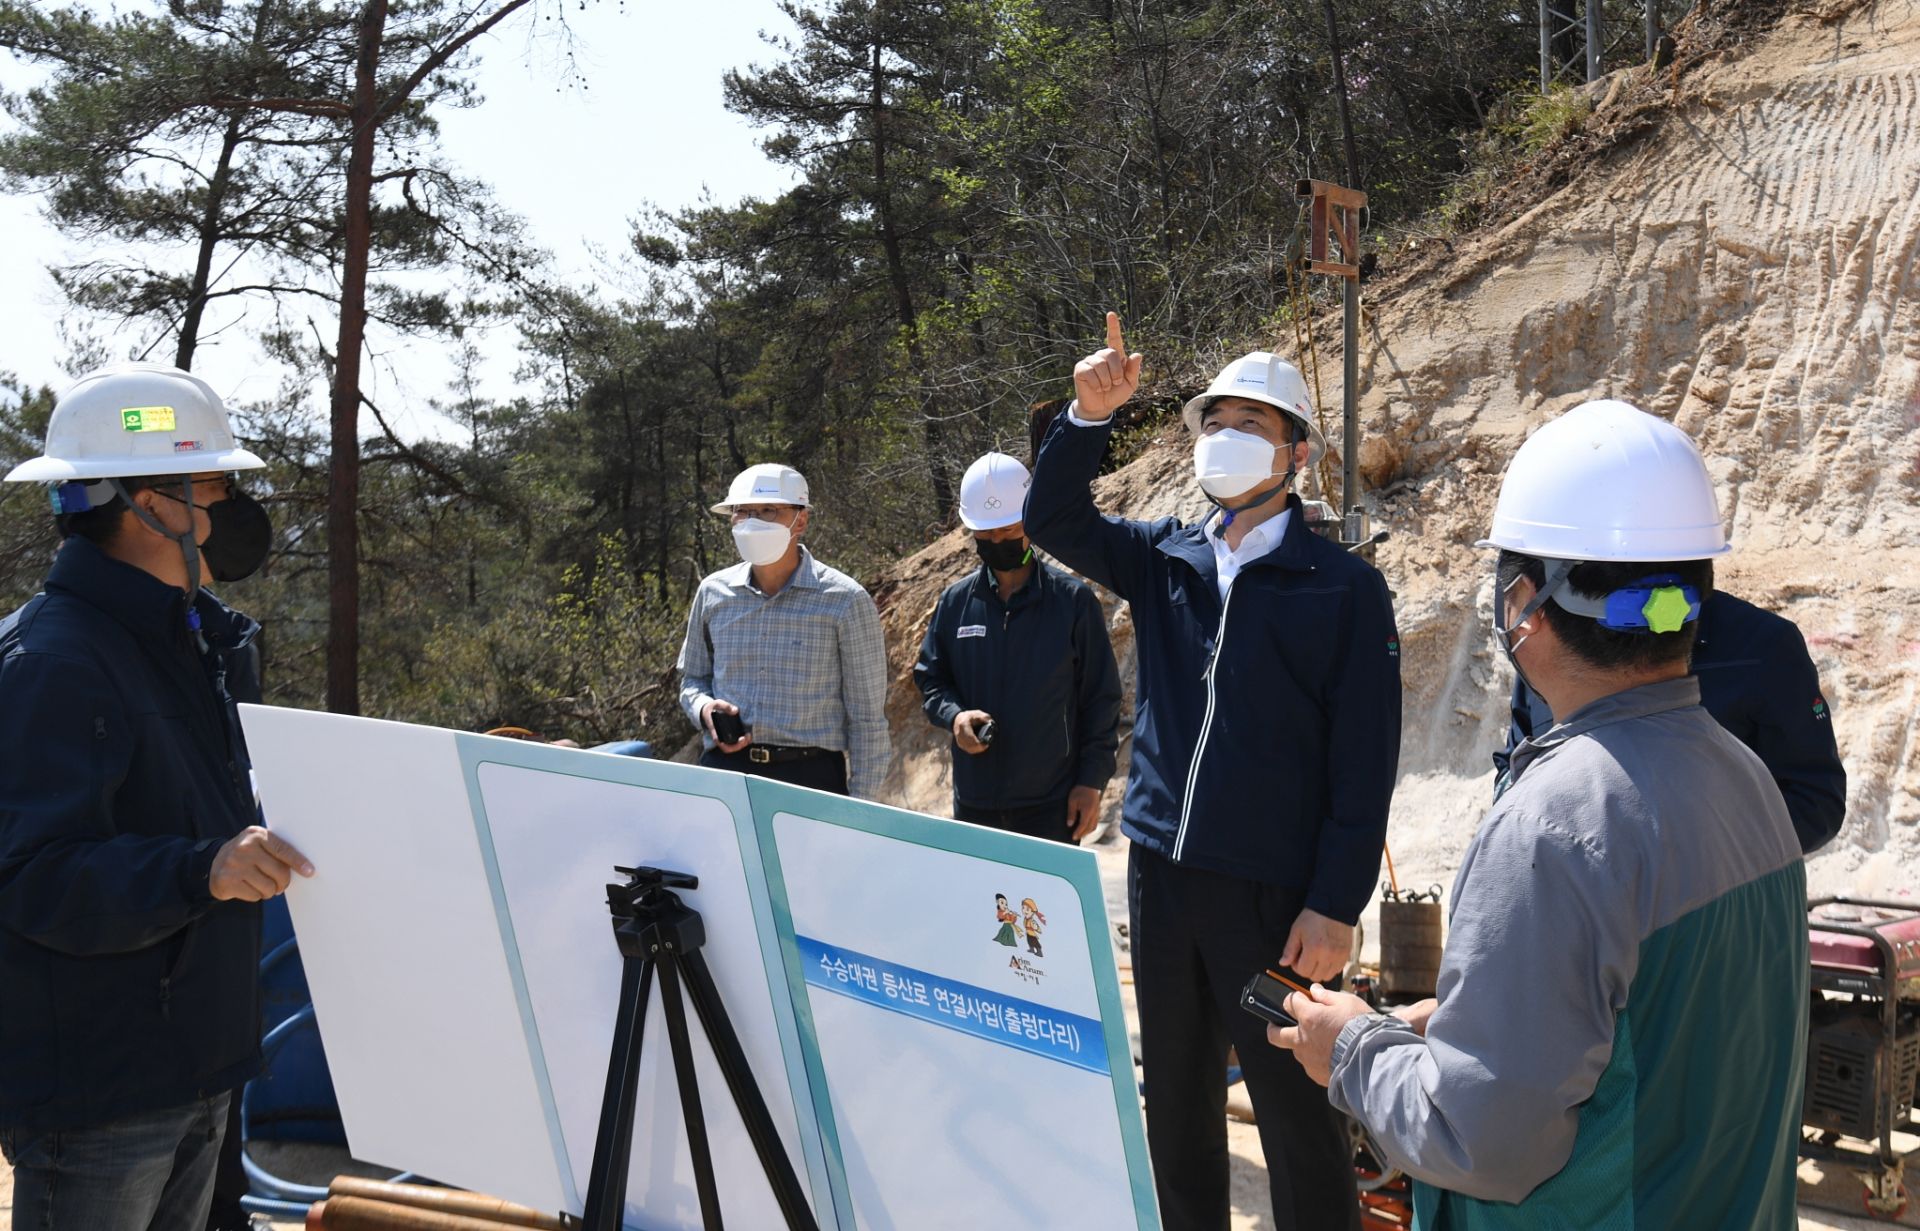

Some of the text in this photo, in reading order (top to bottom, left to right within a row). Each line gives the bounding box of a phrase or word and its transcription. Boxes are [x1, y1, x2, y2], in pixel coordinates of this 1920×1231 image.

[820, 953, 1080, 1054] 수승대권 등산로 연결사업(출렁다리)
